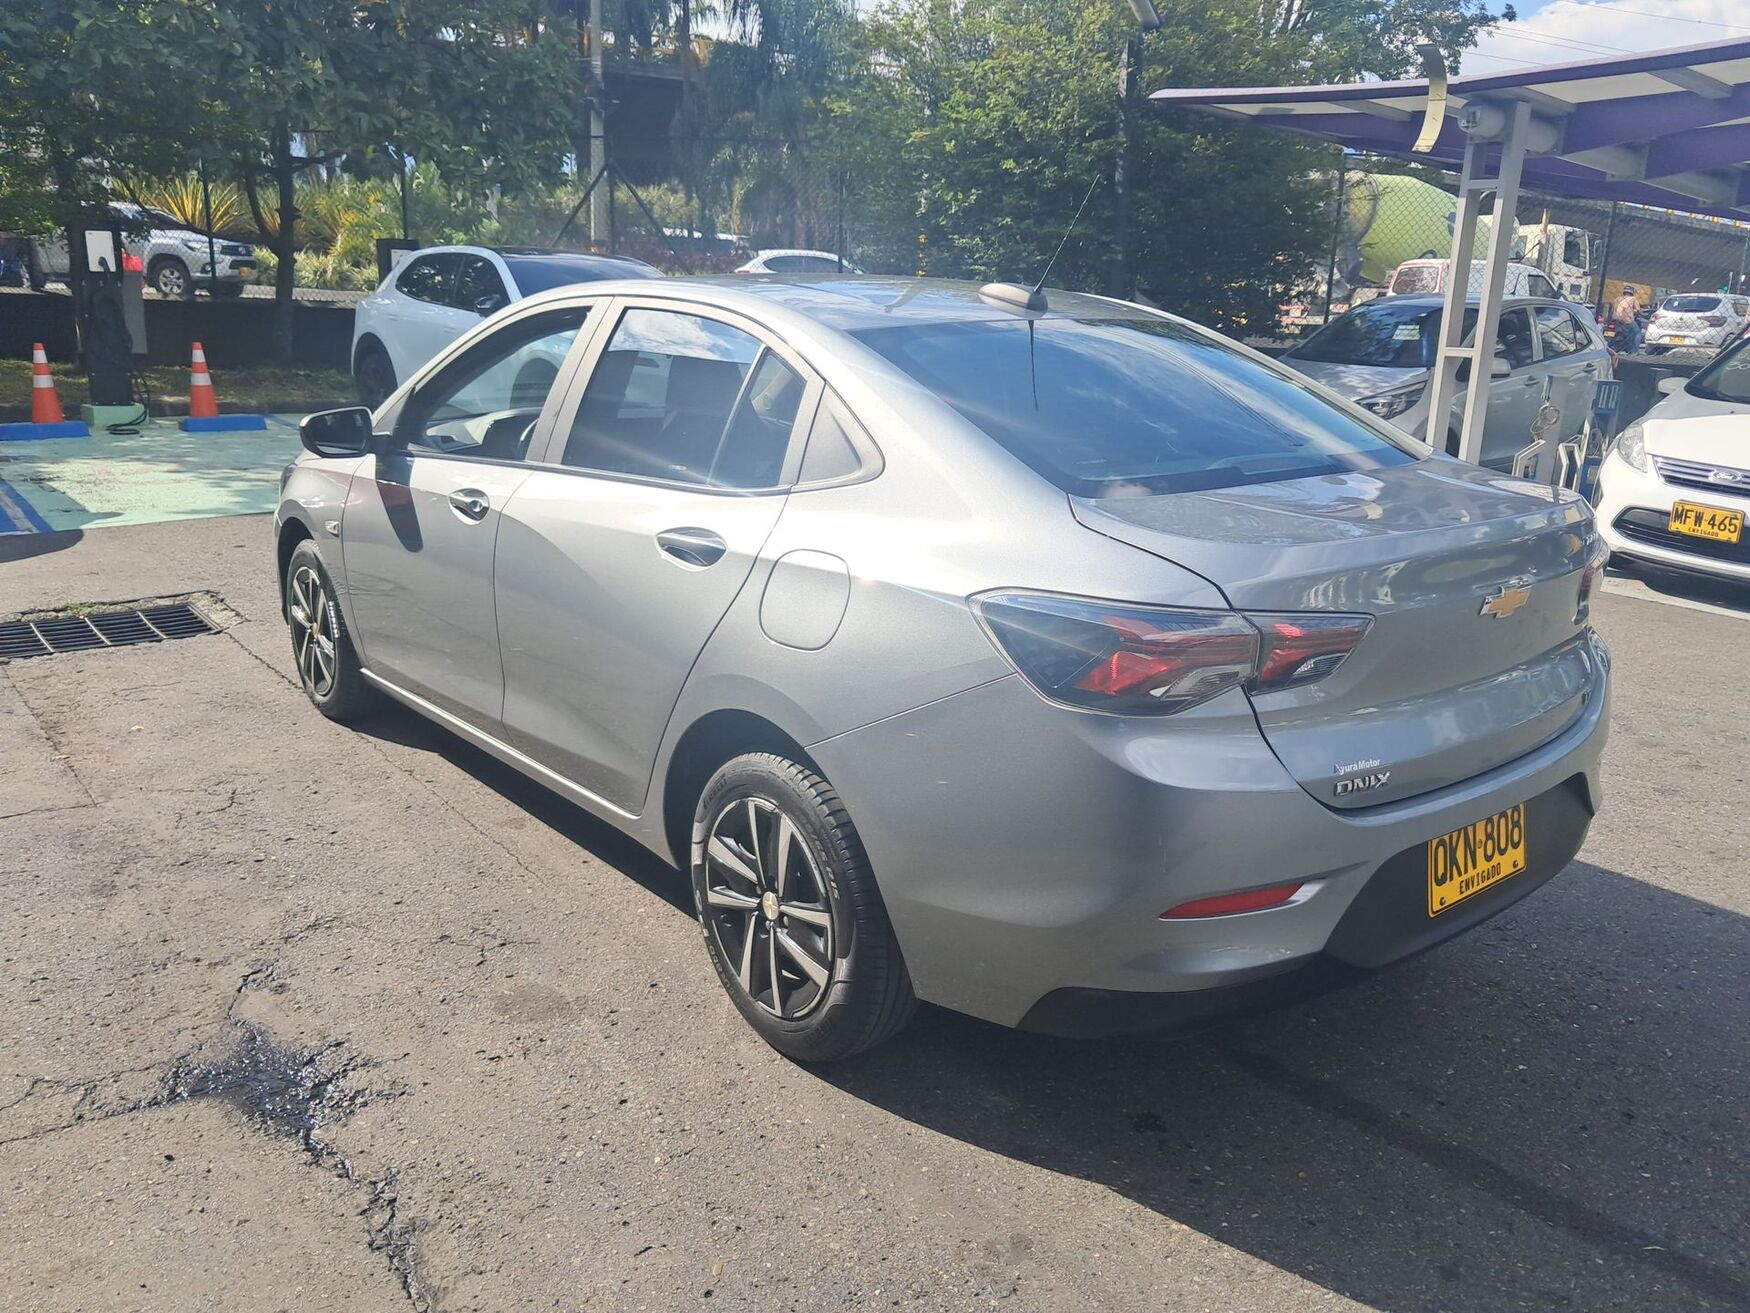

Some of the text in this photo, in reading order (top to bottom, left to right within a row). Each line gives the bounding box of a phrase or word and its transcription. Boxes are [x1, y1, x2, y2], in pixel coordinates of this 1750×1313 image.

[1358, 759, 1381, 770] Motor
[1334, 770, 1392, 796] ONIX
[1458, 862, 1502, 896] ENVIGADO
